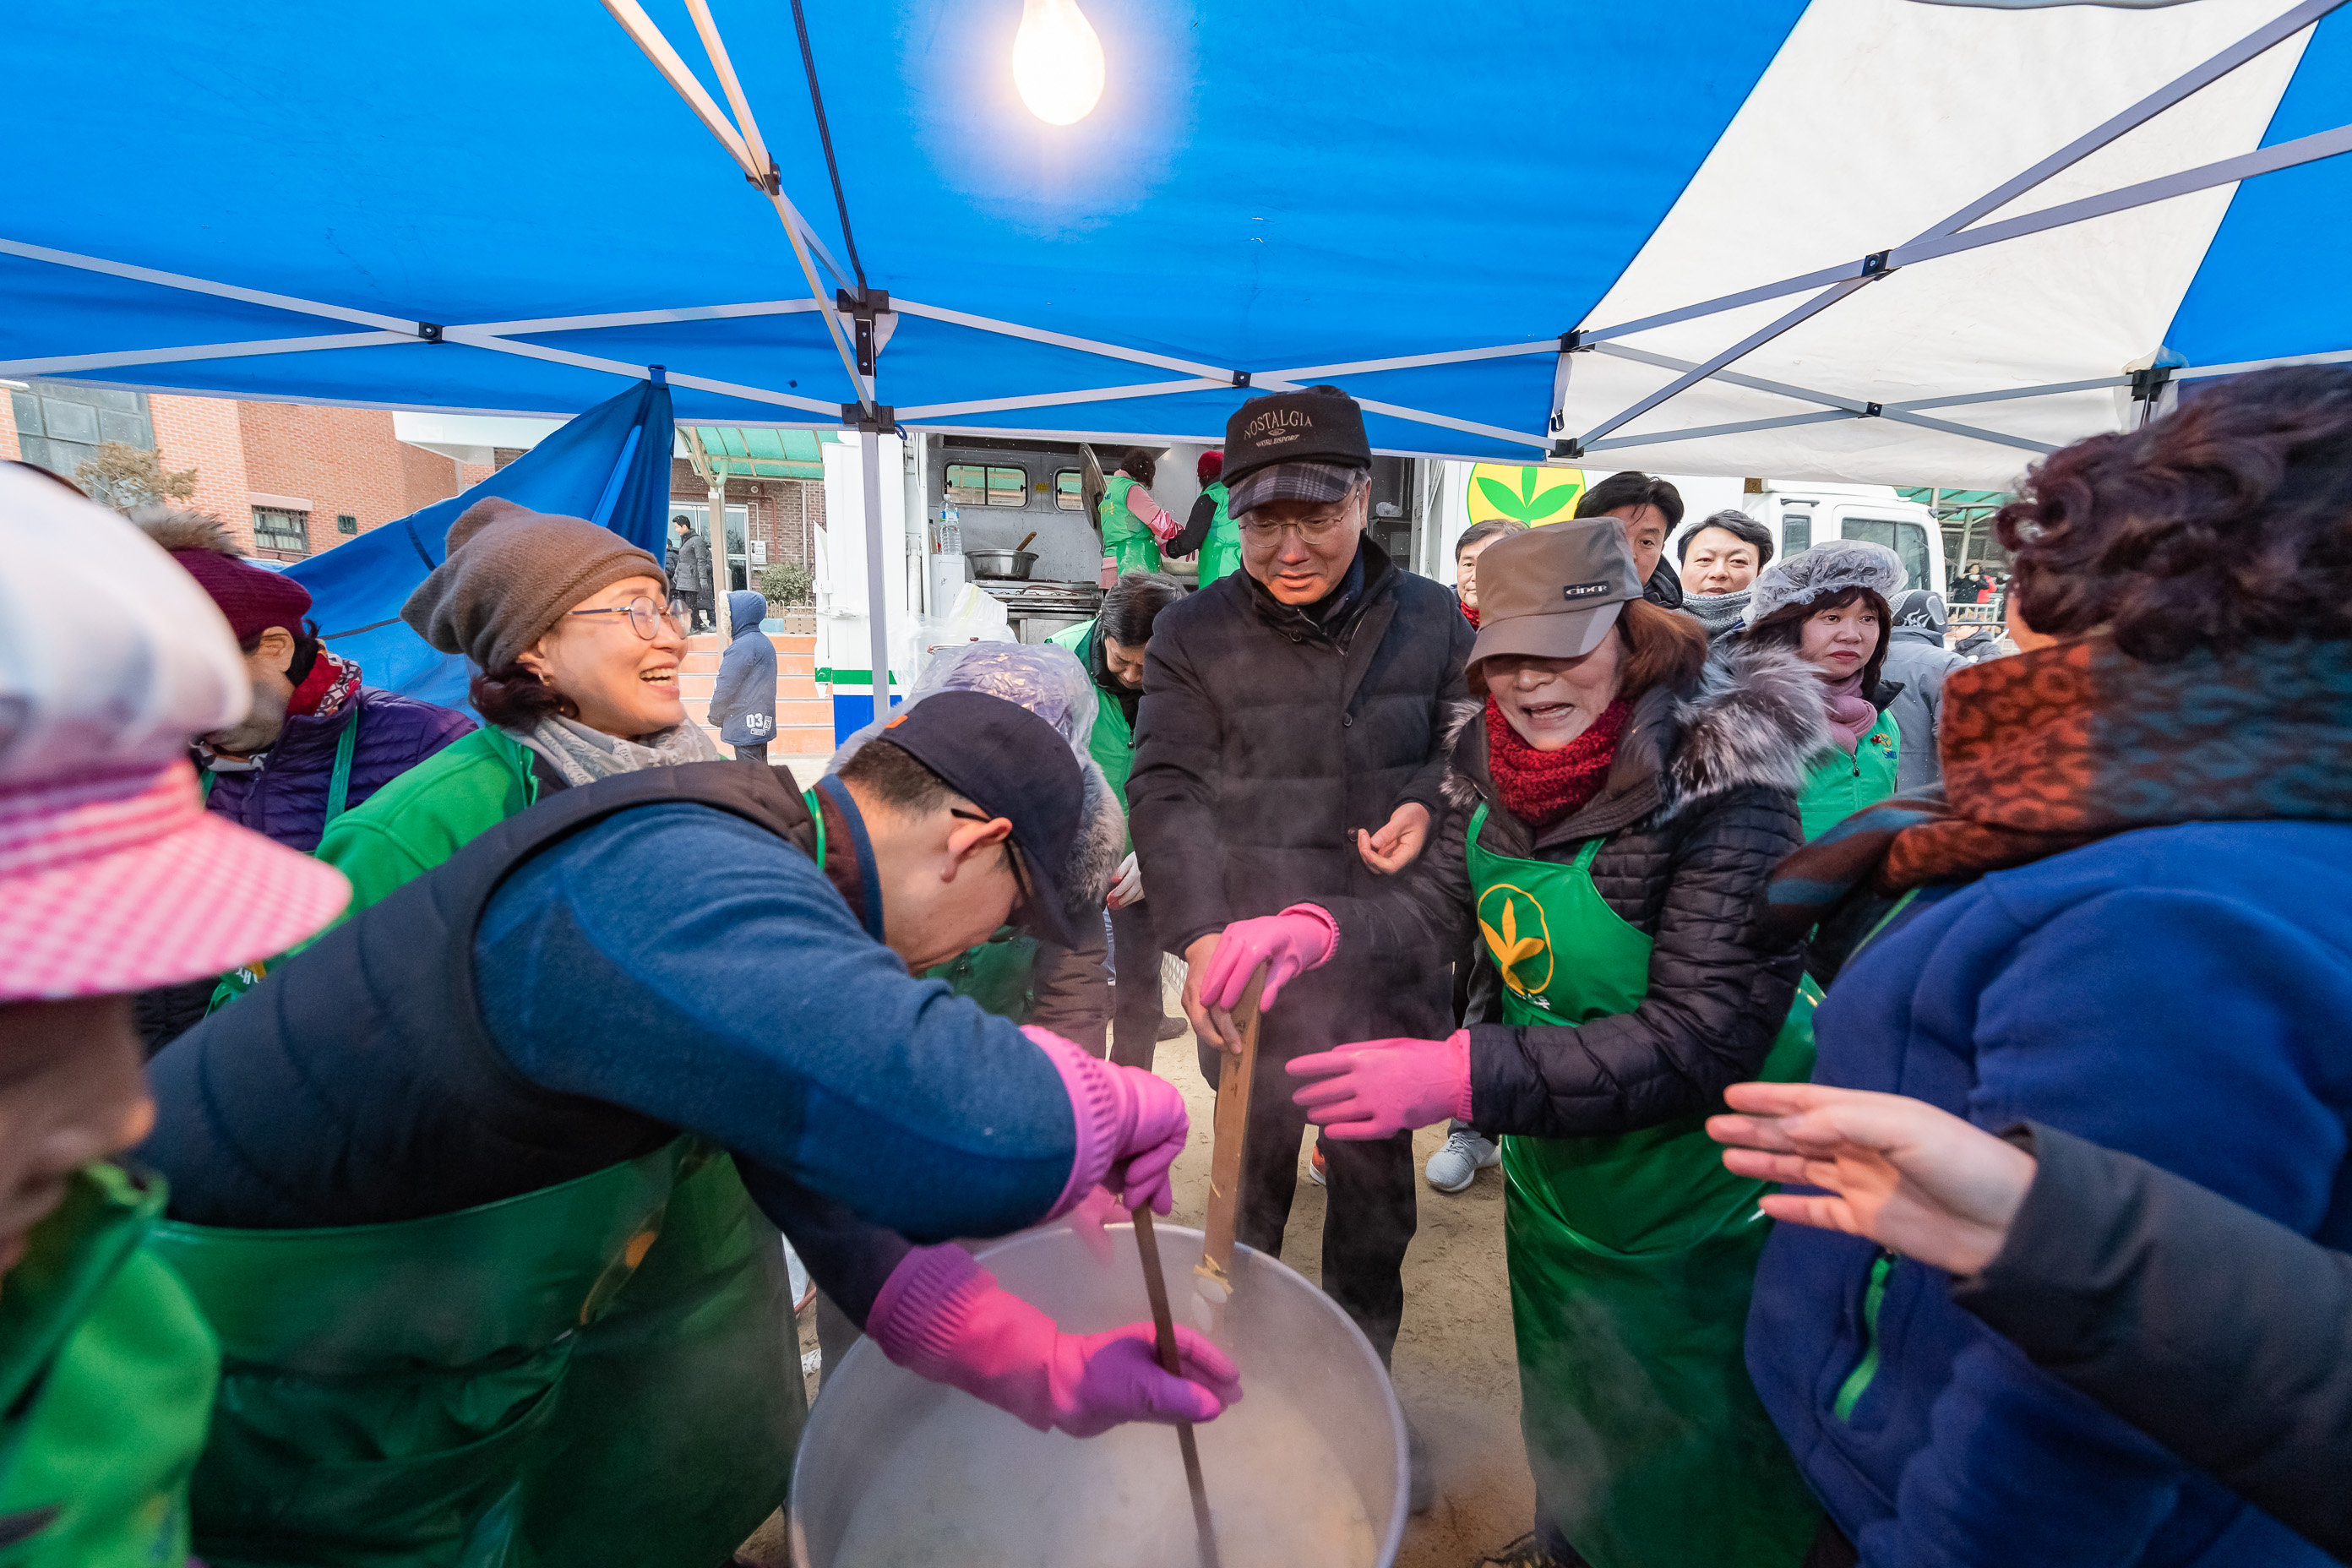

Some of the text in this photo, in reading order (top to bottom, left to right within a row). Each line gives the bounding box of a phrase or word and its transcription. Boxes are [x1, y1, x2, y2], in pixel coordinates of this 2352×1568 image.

[1244, 409, 1313, 439] NOSTALGIA
[1255, 434, 1301, 448] WORLDSPORT
[746, 712, 764, 728] 03
